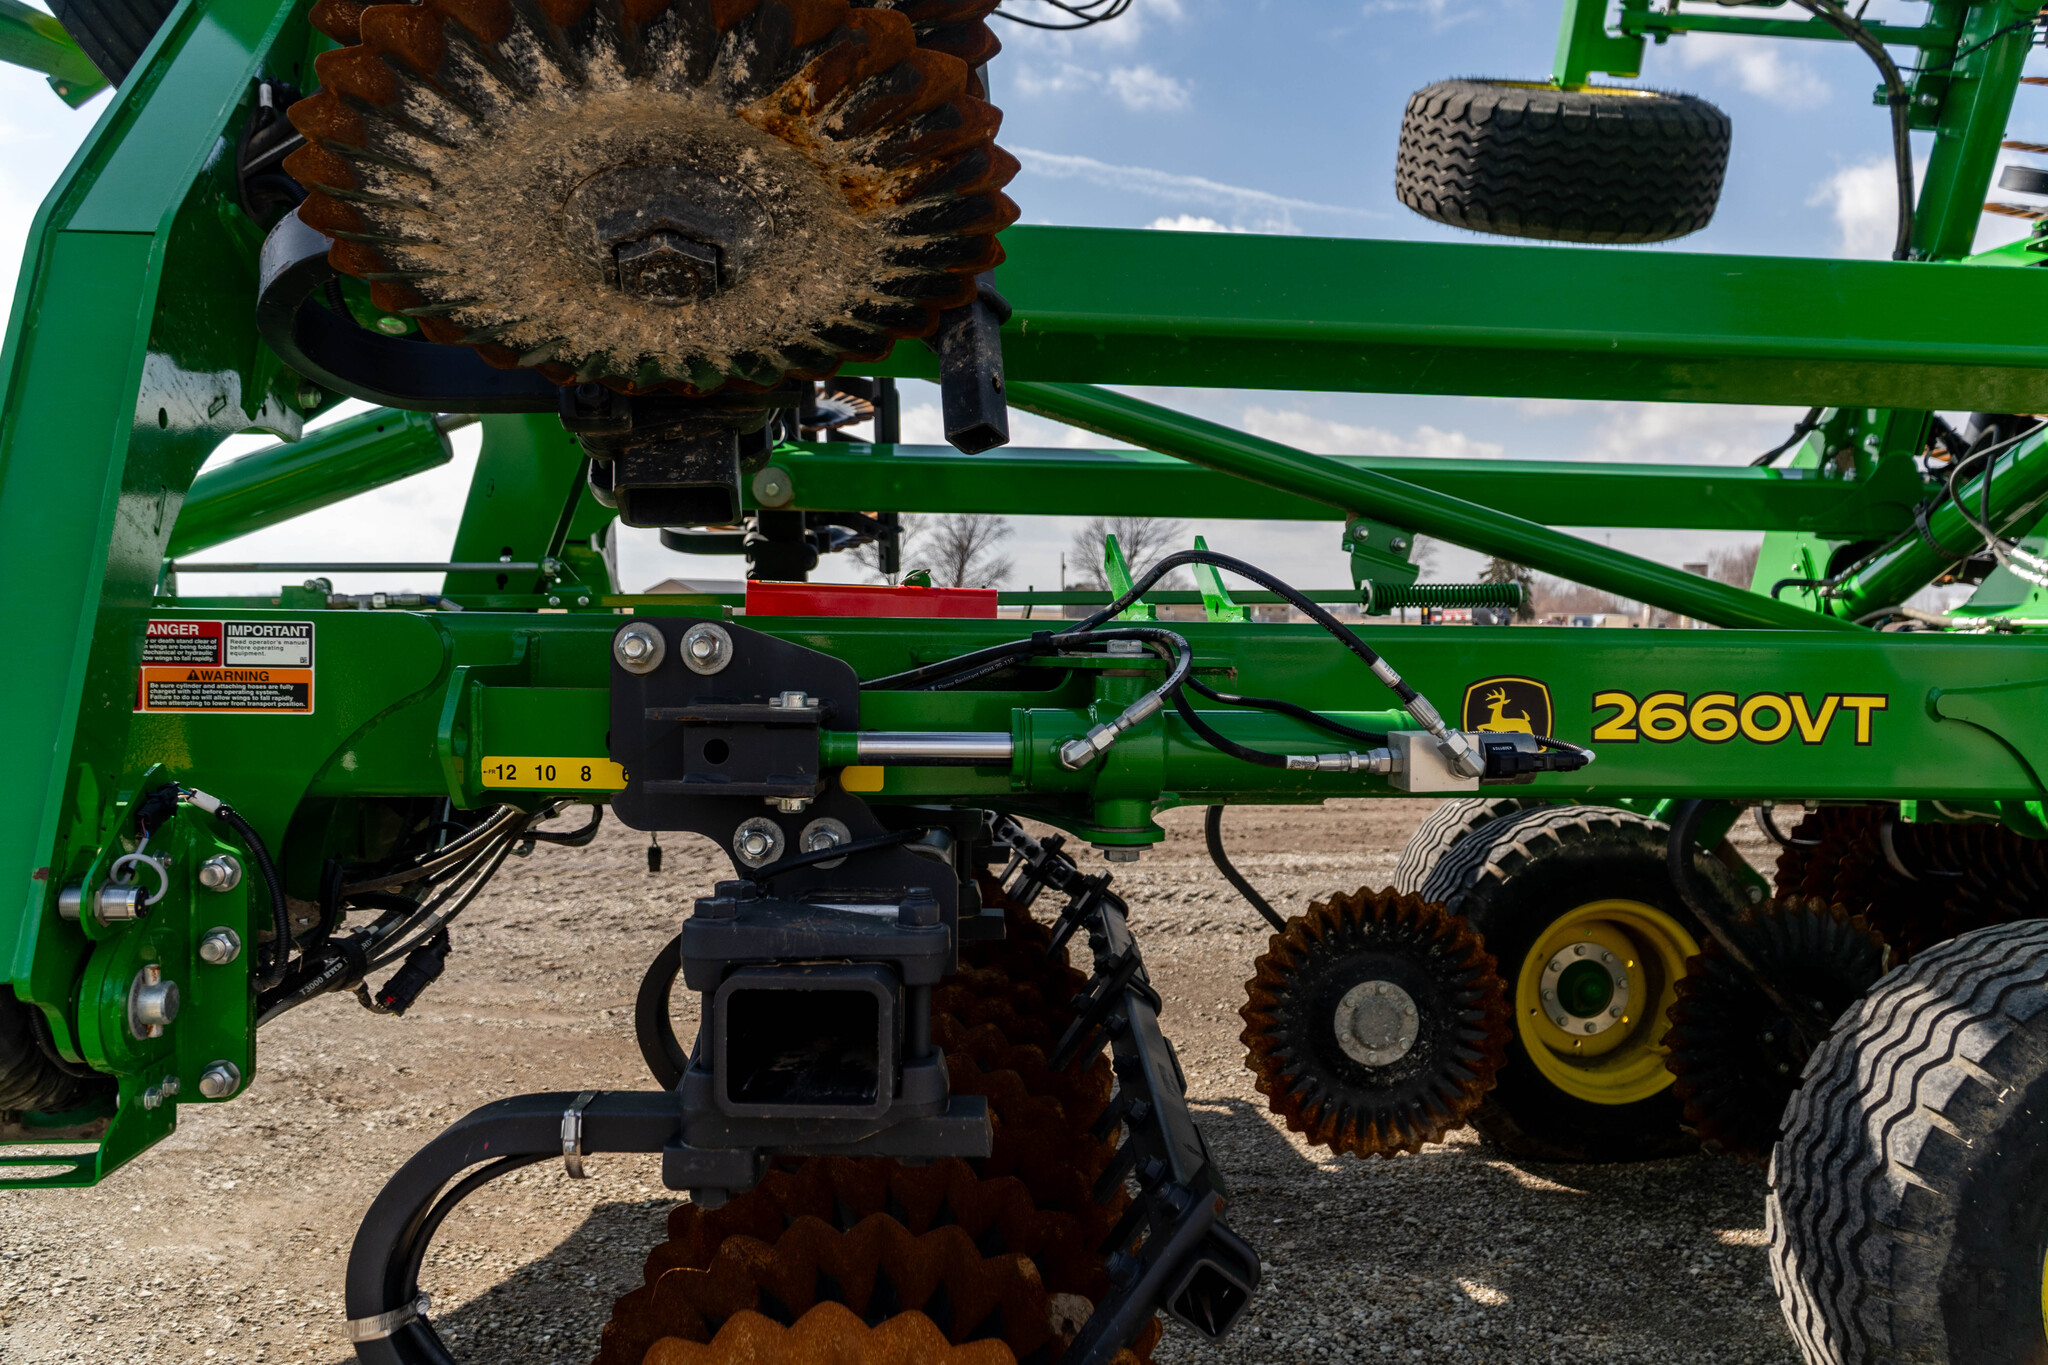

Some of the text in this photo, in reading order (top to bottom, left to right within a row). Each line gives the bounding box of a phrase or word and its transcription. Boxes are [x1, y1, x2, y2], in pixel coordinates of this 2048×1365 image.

[147, 623, 200, 635] ANGER
[228, 625, 309, 636] IMPORTANT
[200, 671, 270, 681] WARNING
[1591, 689, 1889, 746] 2660VT
[496, 764, 516, 780] 12
[534, 765, 556, 781] 10
[580, 766, 592, 782] 8
[299, 976, 323, 995] T3000
